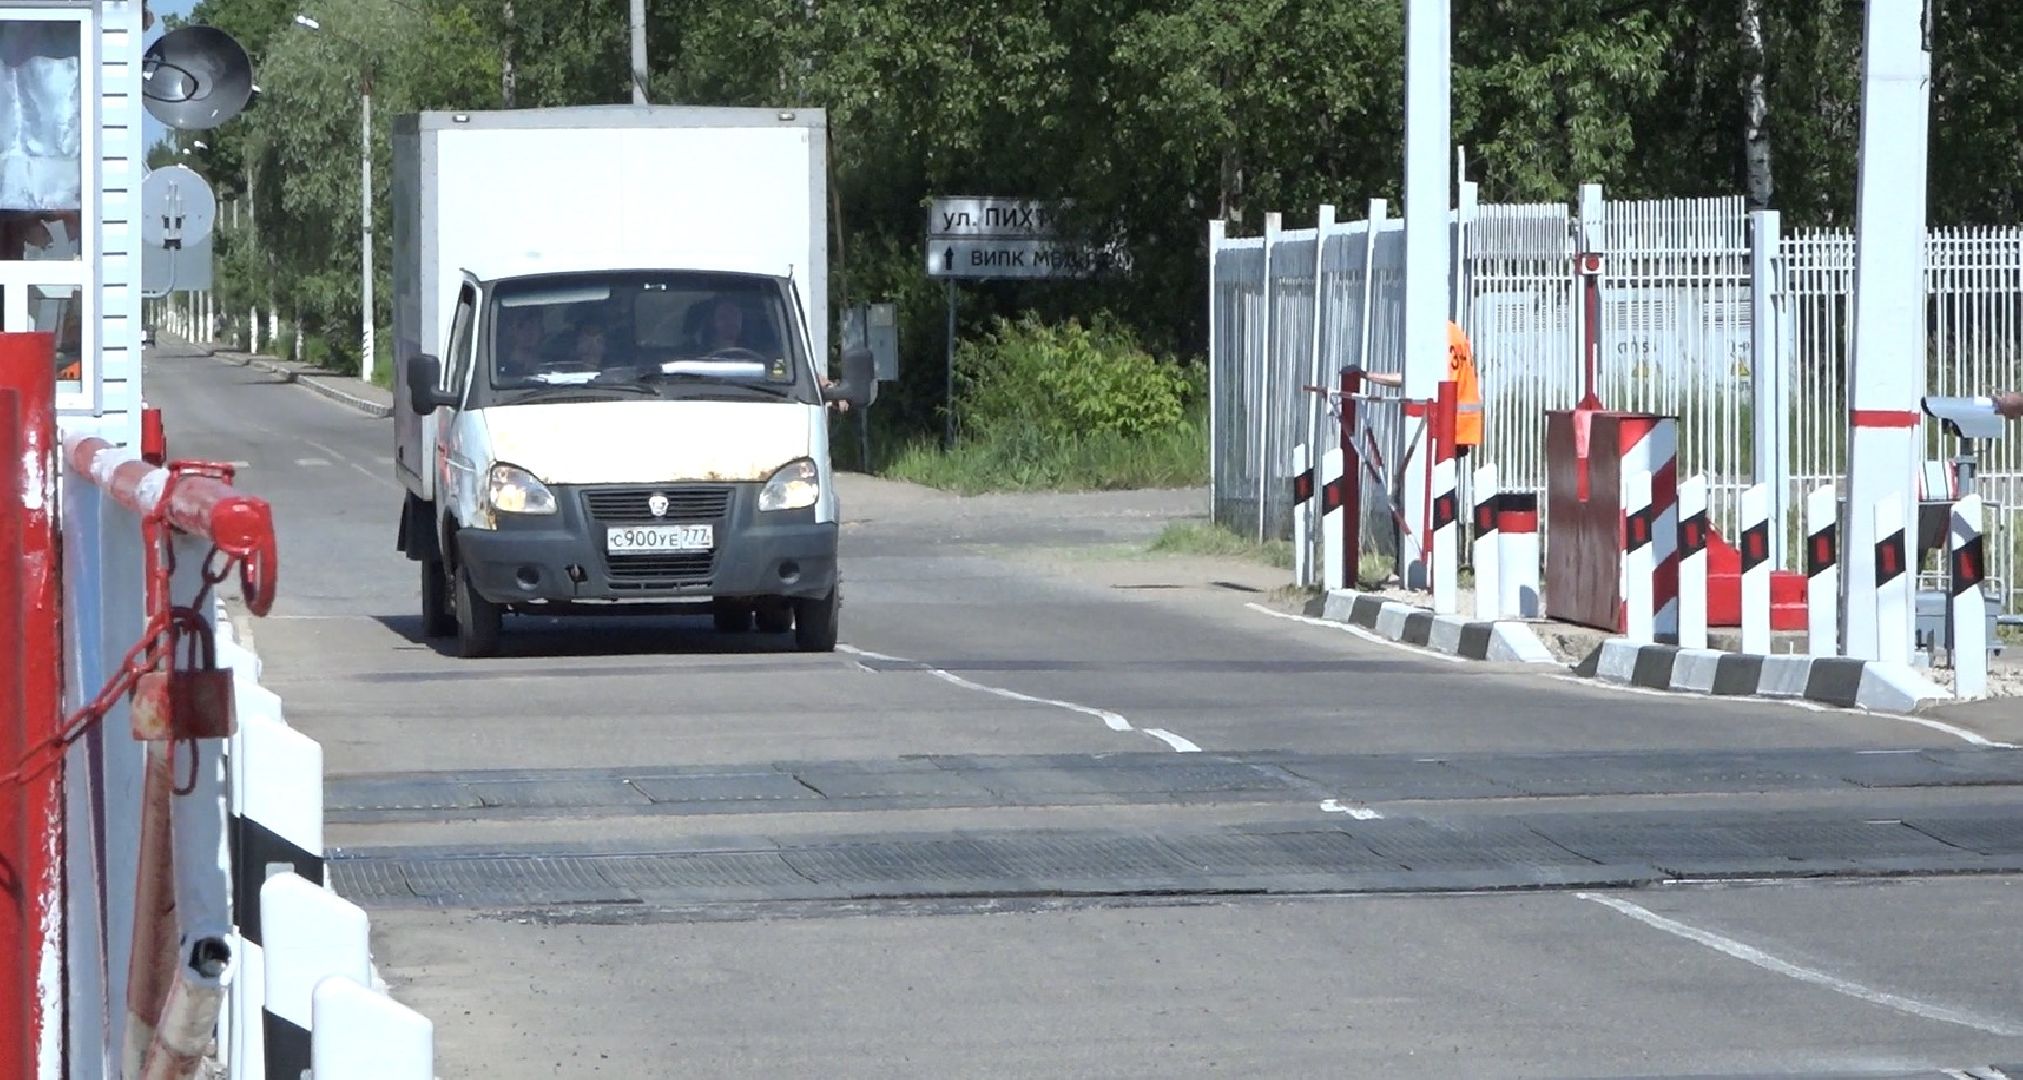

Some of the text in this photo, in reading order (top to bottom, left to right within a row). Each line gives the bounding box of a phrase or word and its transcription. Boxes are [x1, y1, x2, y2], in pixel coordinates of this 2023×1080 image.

[943, 211, 977, 232] ул.
[971, 251, 1023, 266] ВИПК
[682, 528, 708, 542] 777
